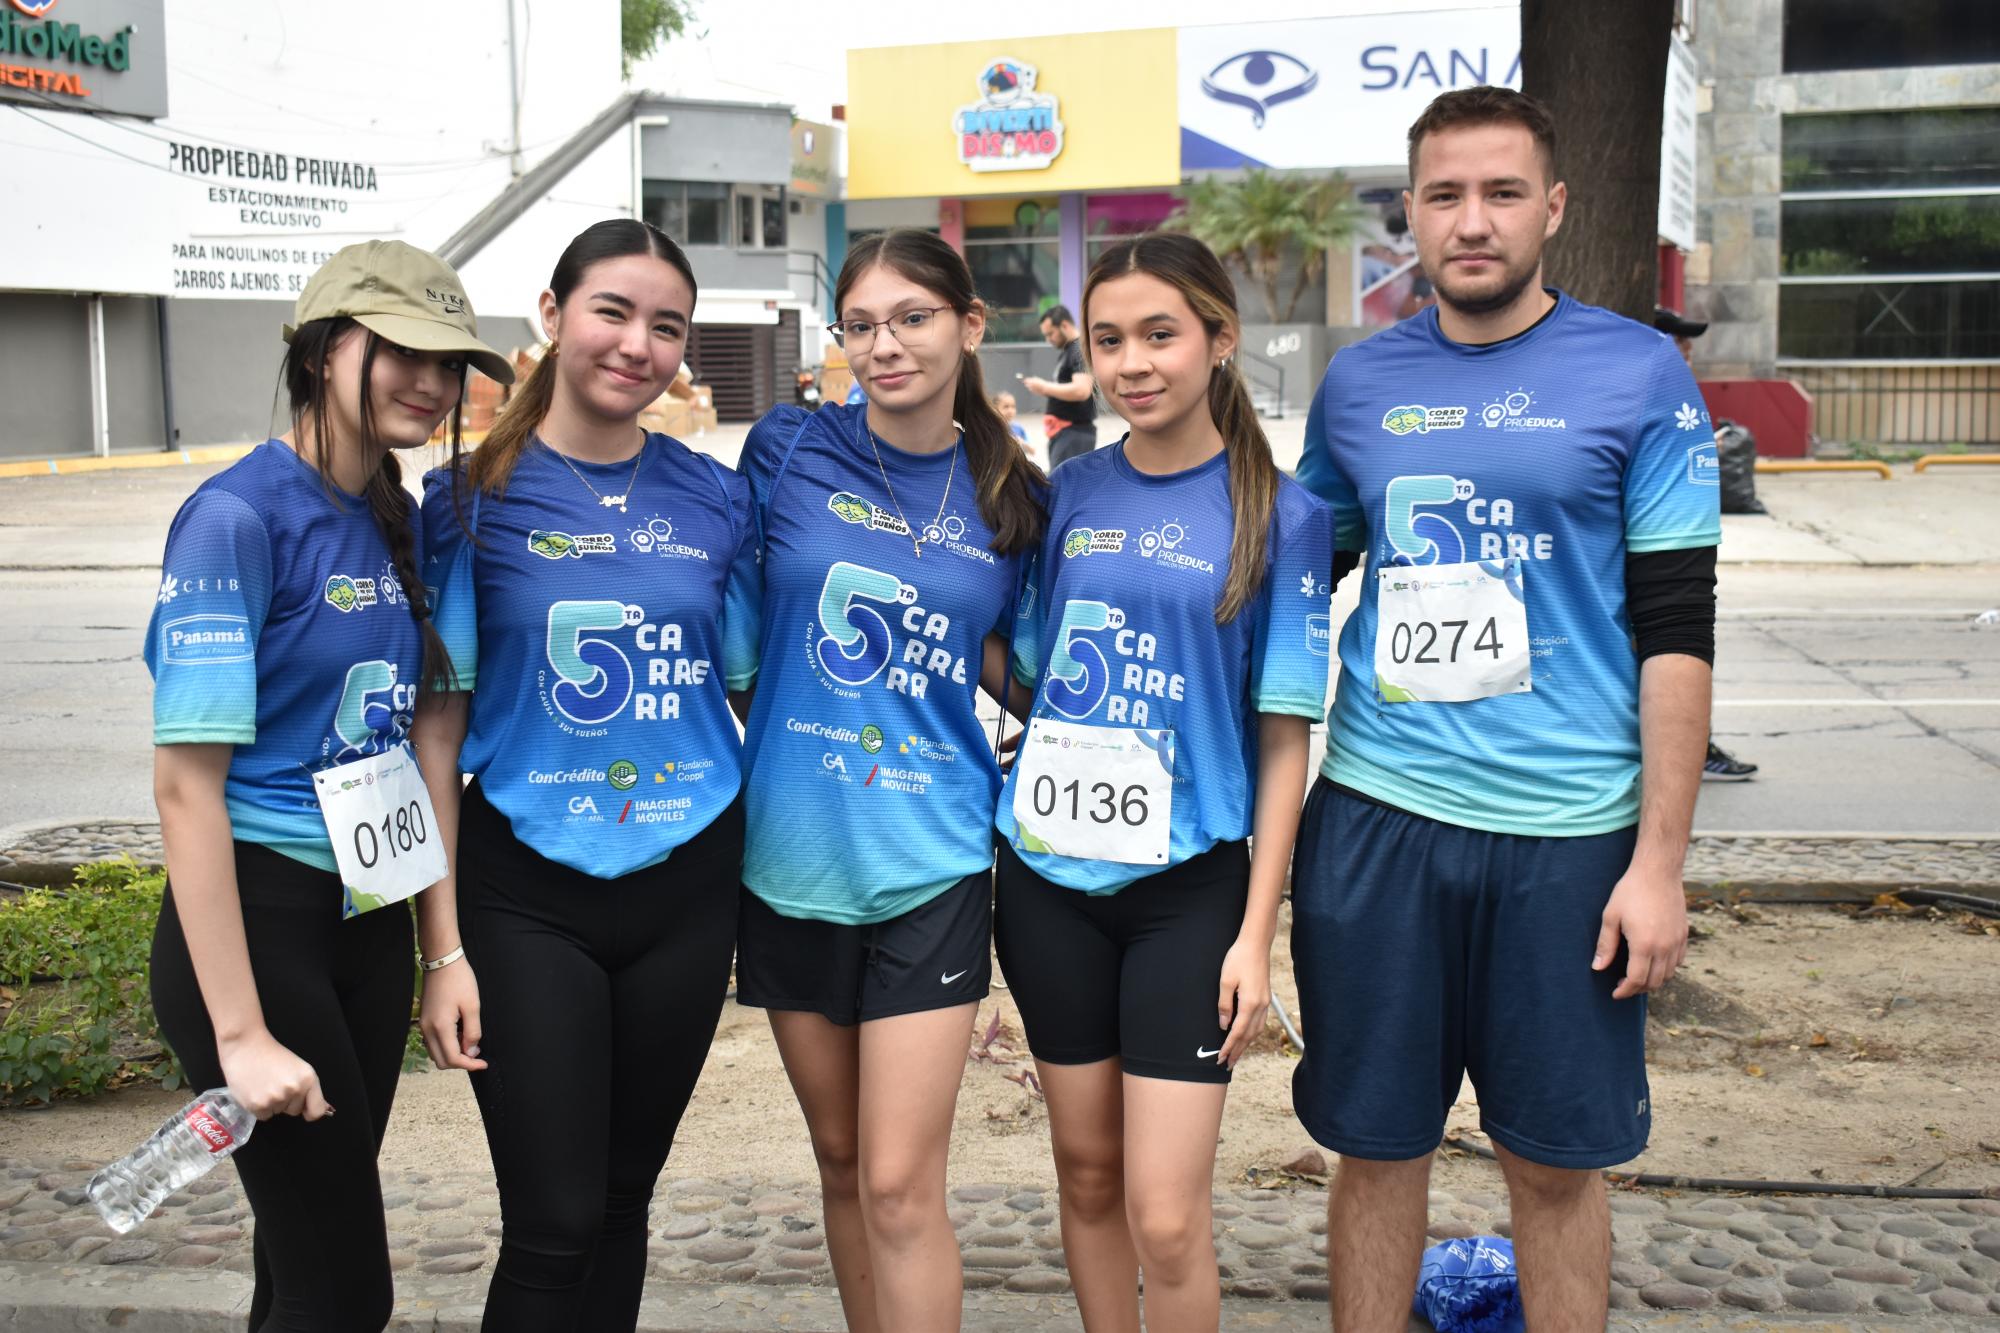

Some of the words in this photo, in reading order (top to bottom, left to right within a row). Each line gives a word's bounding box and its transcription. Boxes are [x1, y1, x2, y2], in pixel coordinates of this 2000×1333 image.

[296, 156, 378, 192] PRIVADA
[208, 187, 348, 213] ESTACIONAMIENTO
[240, 209, 322, 228] EXCLUSIVO
[173, 244, 207, 260] PARA
[211, 245, 288, 263] INQUILINOS
[293, 250, 308, 264] DE
[174, 269, 226, 289] CARROS
[1504, 417, 1566, 429] PROEDUCA
[1466, 498, 1514, 527] CA
[1089, 542, 1120, 551] SUEÑOS
[1094, 531, 1124, 539] CORRO
[1480, 532, 1554, 561] RRE
[656, 543, 709, 561] PROEDUCA
[946, 540, 995, 566] PROEDUCA
[1157, 549, 1214, 574] PROEDUCA
[171, 627, 247, 647] Panamá
[635, 623, 683, 652] CA
[817, 561, 901, 686] 5
[902, 606, 950, 642] CA
[1115, 629, 1158, 662] CA
[1391, 616, 1504, 665] 0274
[546, 600, 634, 725] 5
[624, 610, 641, 620] TA
[1045, 599, 1110, 720] 5
[885, 666, 930, 700] RA
[1122, 662, 1186, 702] RRE
[635, 692, 681, 721] RA
[1106, 695, 1150, 728] RA
[787, 718, 859, 743] ConCrédito
[920, 747, 955, 762] Coppel
[528, 768, 606, 785] ConCrédito
[1033, 774, 1149, 827] 0136
[353, 799, 427, 869] 0180
